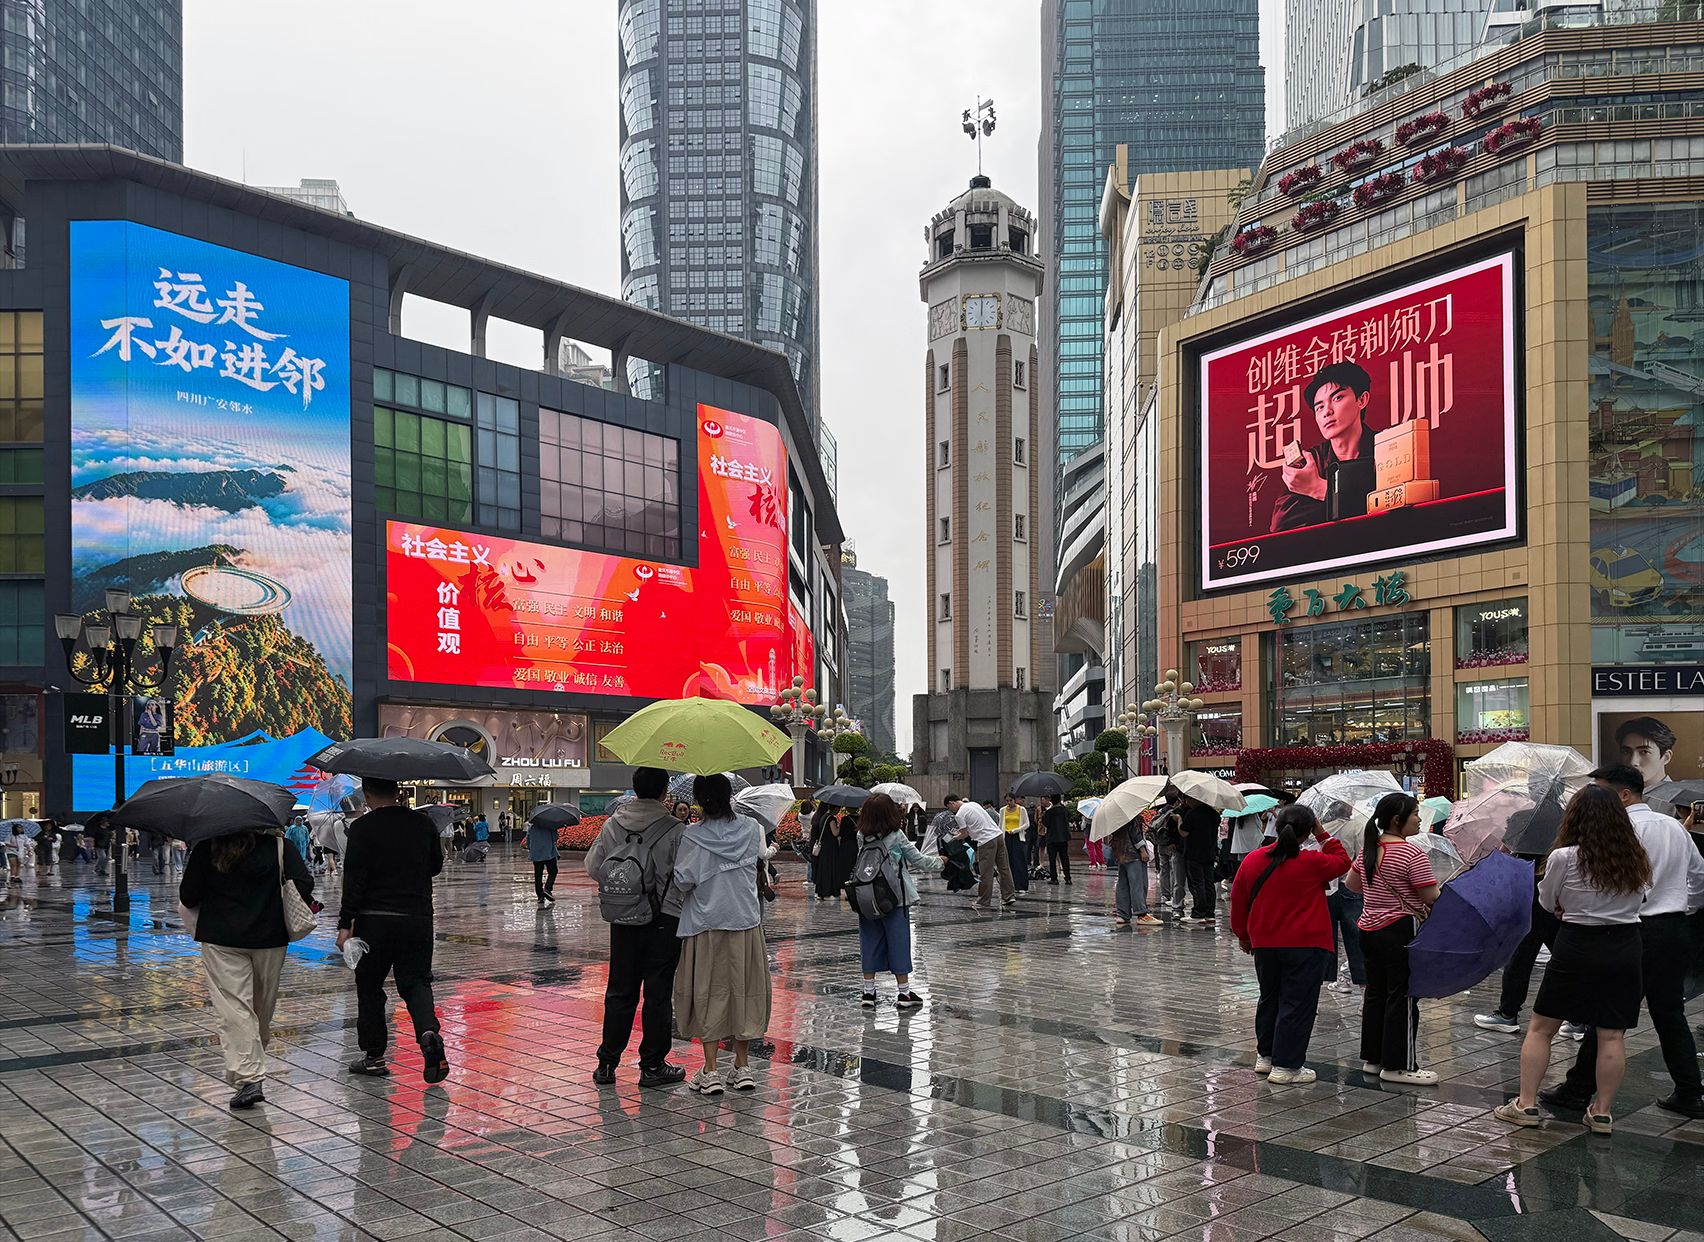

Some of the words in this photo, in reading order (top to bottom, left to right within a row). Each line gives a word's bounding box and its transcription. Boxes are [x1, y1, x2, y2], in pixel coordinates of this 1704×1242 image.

[153, 267, 291, 341] 远走
[1246, 294, 1453, 394] 创维金砖剃须刀
[88, 316, 326, 411] 不如进邻
[176, 390, 253, 415] 四川广安邻水
[1245, 385, 1302, 475] 超
[1390, 342, 1454, 430] 帅
[710, 454, 772, 487] 社会主义
[1377, 453, 1410, 472] GOLD
[401, 533, 491, 566] 社会主义
[729, 545, 751, 561] 富强
[753, 549, 771, 563] 民主
[1217, 545, 1261, 570] ¥599
[730, 577, 750, 590] 自由
[754, 582, 772, 595] 平等
[436, 581, 461, 655] 价值观
[512, 598, 540, 614] 富强
[543, 602, 568, 617] 民主
[573, 605, 596, 620] 文明
[599, 608, 624, 624] 和谐
[730, 610, 751, 623] 爱国
[754, 612, 772, 626] 敬业
[513, 631, 539, 647] 自由
[543, 635, 568, 651] 平等
[572, 636, 596, 652] 公正
[599, 640, 624, 655] 法治
[513, 667, 540, 682] 爱国
[543, 669, 569, 685] 敬业
[573, 671, 597, 687] 诚信
[601, 674, 625, 689] 友善
[70, 714, 103, 724] MLB
[501, 757, 539, 767] ZHOU
[542, 757, 562, 768] LIU
[564, 758, 581, 768] FU
[510, 772, 552, 787] 周六福
